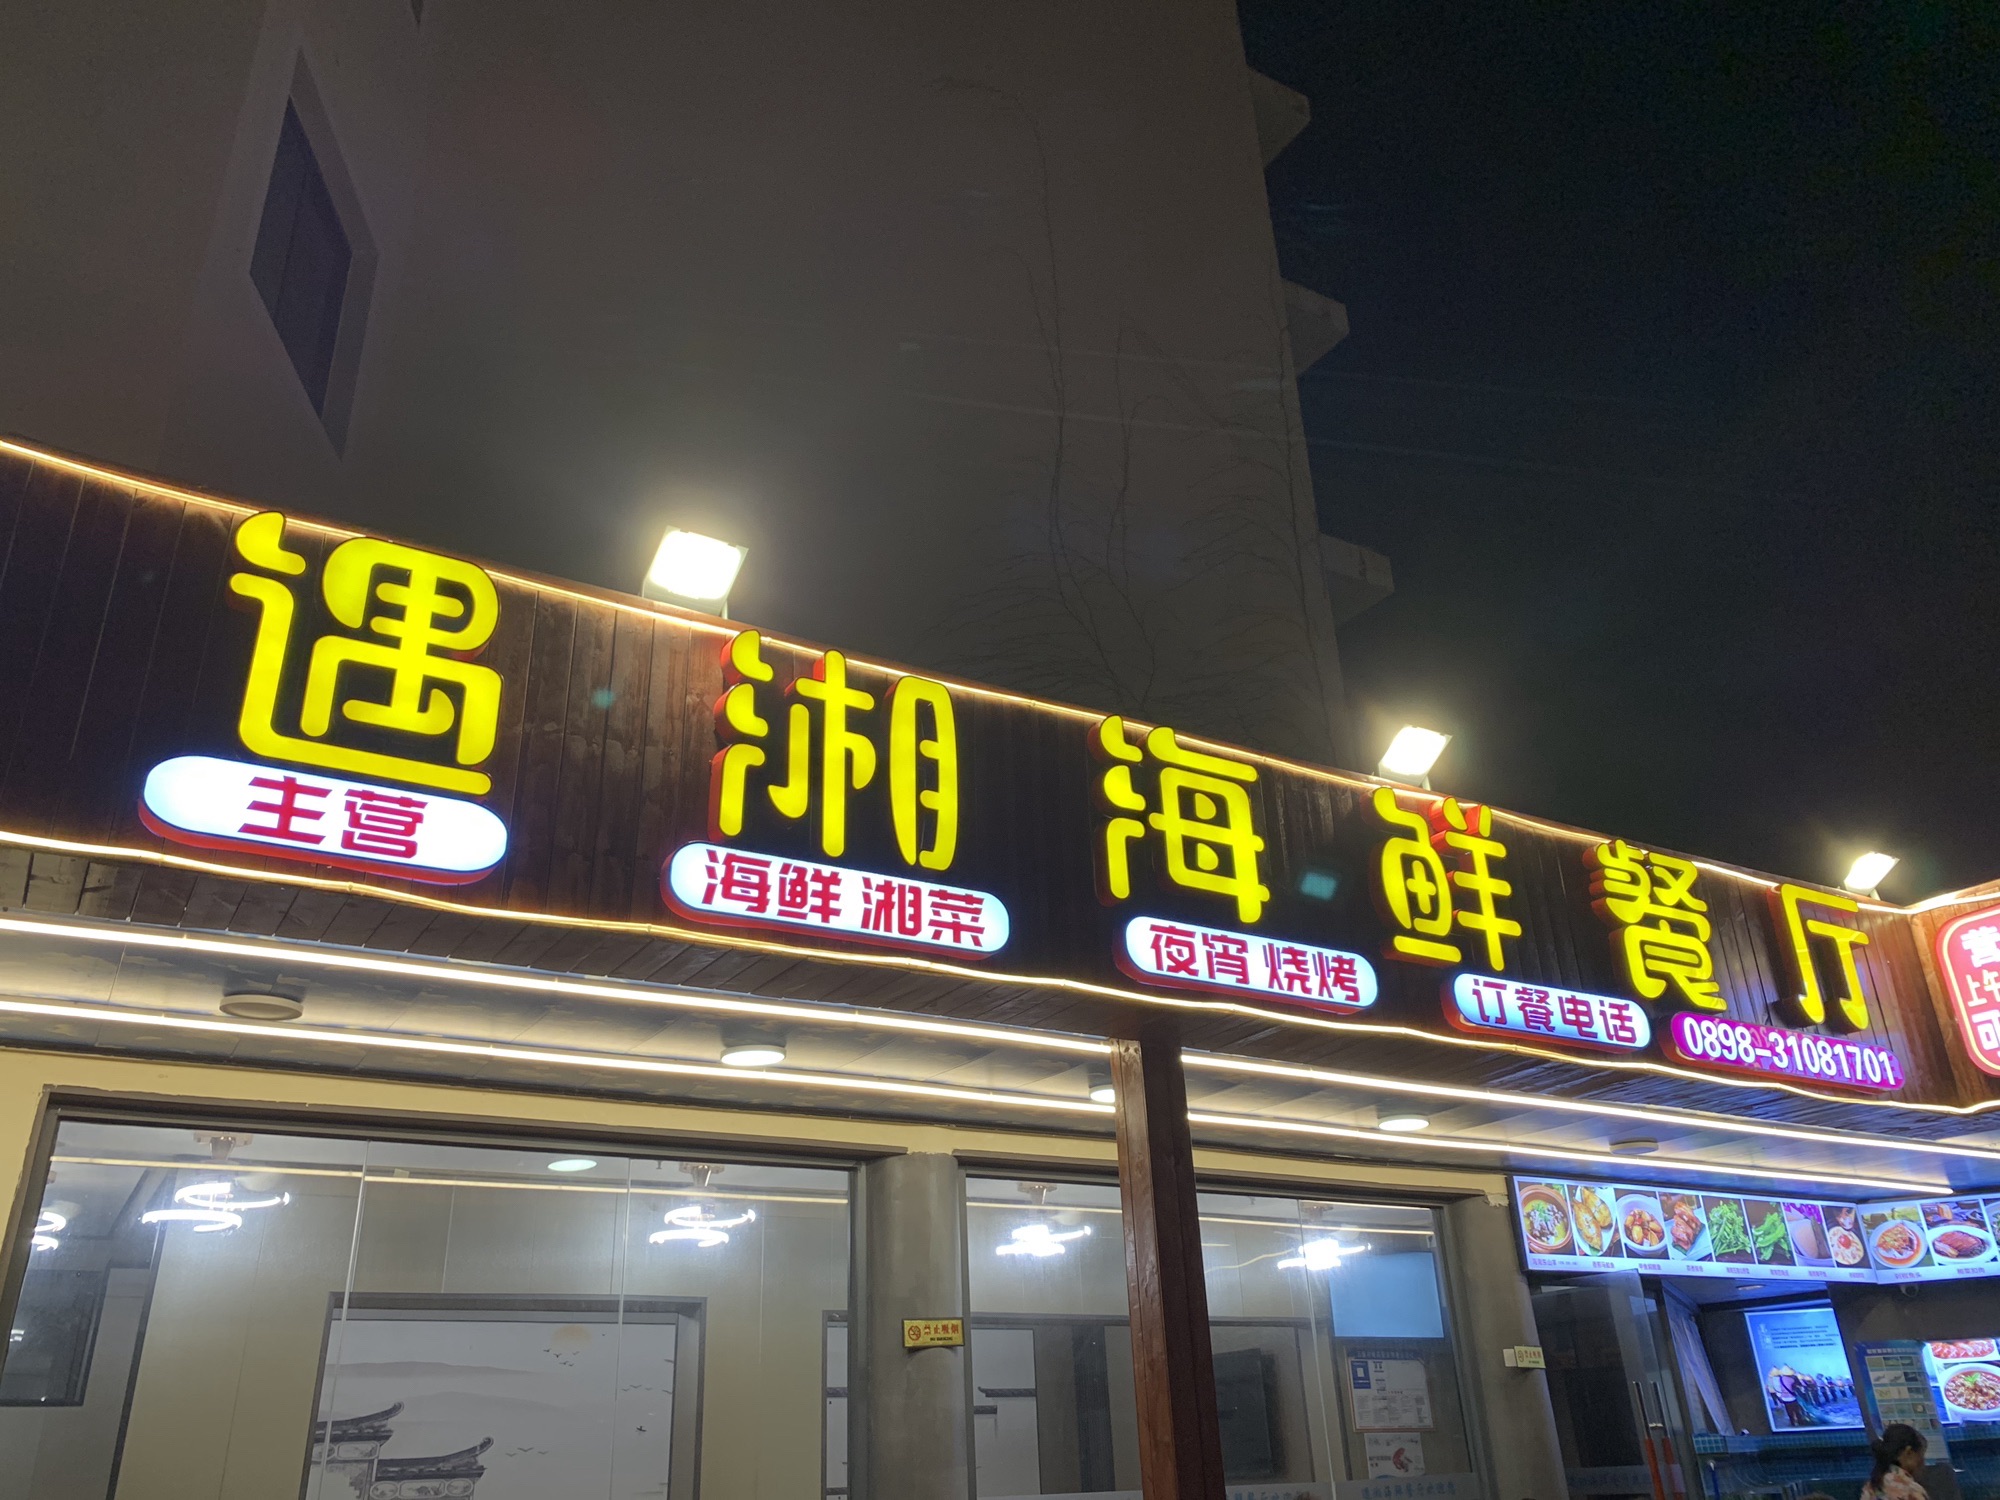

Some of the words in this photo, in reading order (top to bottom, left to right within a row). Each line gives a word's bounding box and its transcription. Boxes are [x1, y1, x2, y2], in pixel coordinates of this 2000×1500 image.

[229, 511, 1869, 1031] 遇湘海鲜餐厅
[237, 775, 429, 859] 主营
[701, 848, 842, 924] 海鲜
[861, 875, 985, 948] 湘菜
[1149, 923, 1250, 985] 夜宵
[1263, 941, 1361, 1003] 烧烤
[1471, 978, 1637, 1044] 订餐电话
[1683, 1016, 1896, 1086] 0898-31081701
